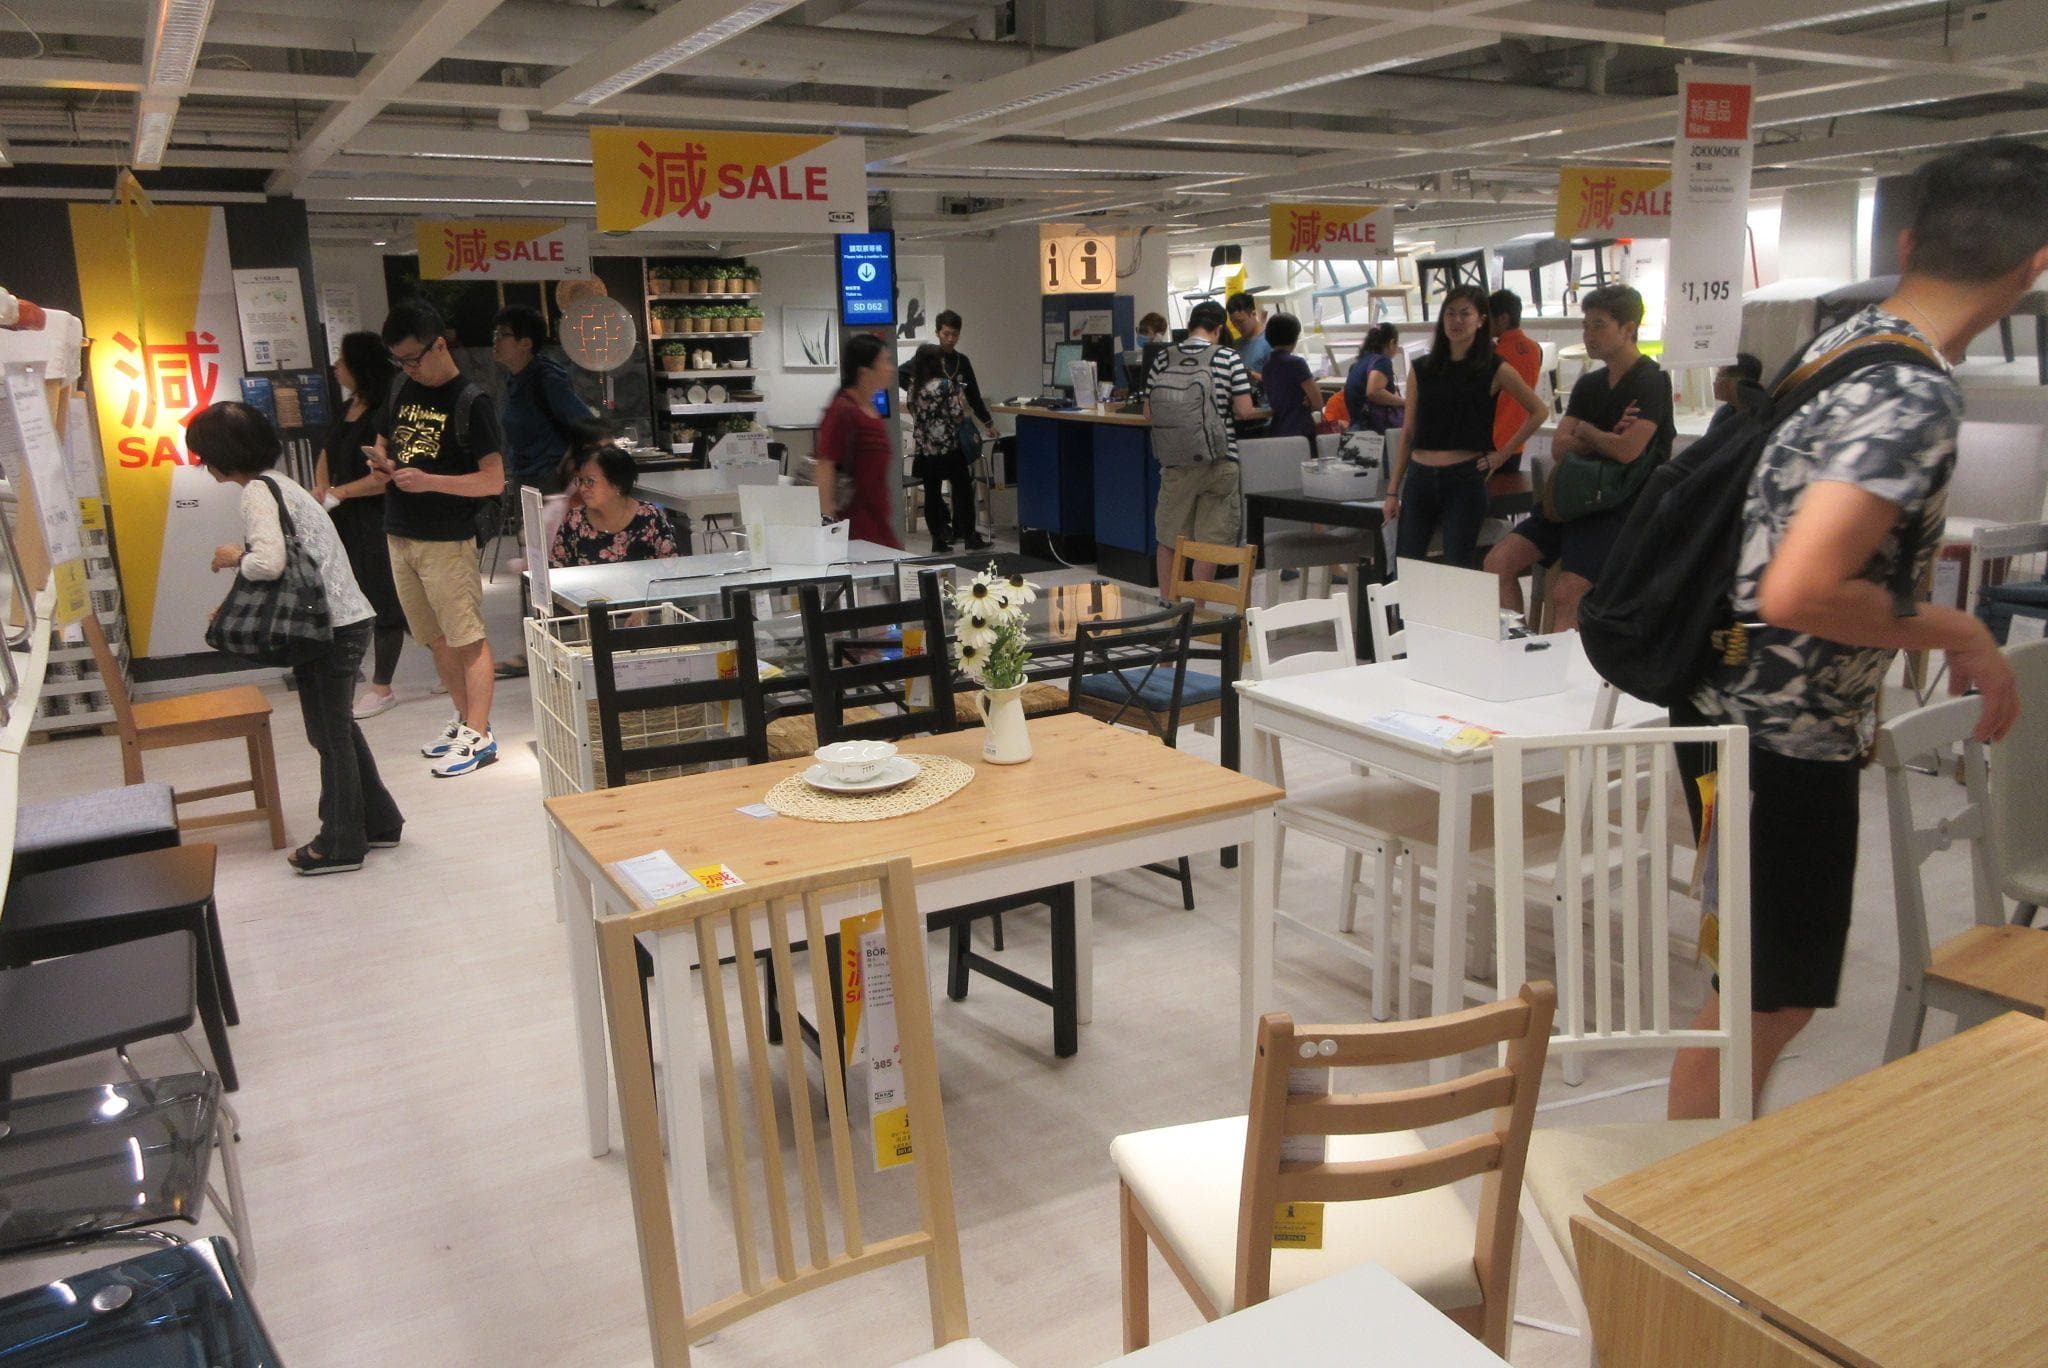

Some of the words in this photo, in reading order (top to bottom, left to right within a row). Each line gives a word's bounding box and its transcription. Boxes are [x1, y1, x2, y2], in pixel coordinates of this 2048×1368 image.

[1690, 145, 1741, 157] JOKKMOKK
[637, 140, 711, 219] 減
[718, 164, 828, 200] SALE
[1578, 176, 1615, 230] 減
[1289, 210, 1322, 253] 減
[1324, 222, 1376, 244] SALE
[444, 228, 491, 272] 減
[494, 240, 565, 262] SALE
[853, 303, 865, 311] SD
[867, 303, 882, 311] 062
[1681, 281, 1730, 304] $1,195
[112, 331, 220, 429] 減
[867, 946, 889, 957] BÖR
